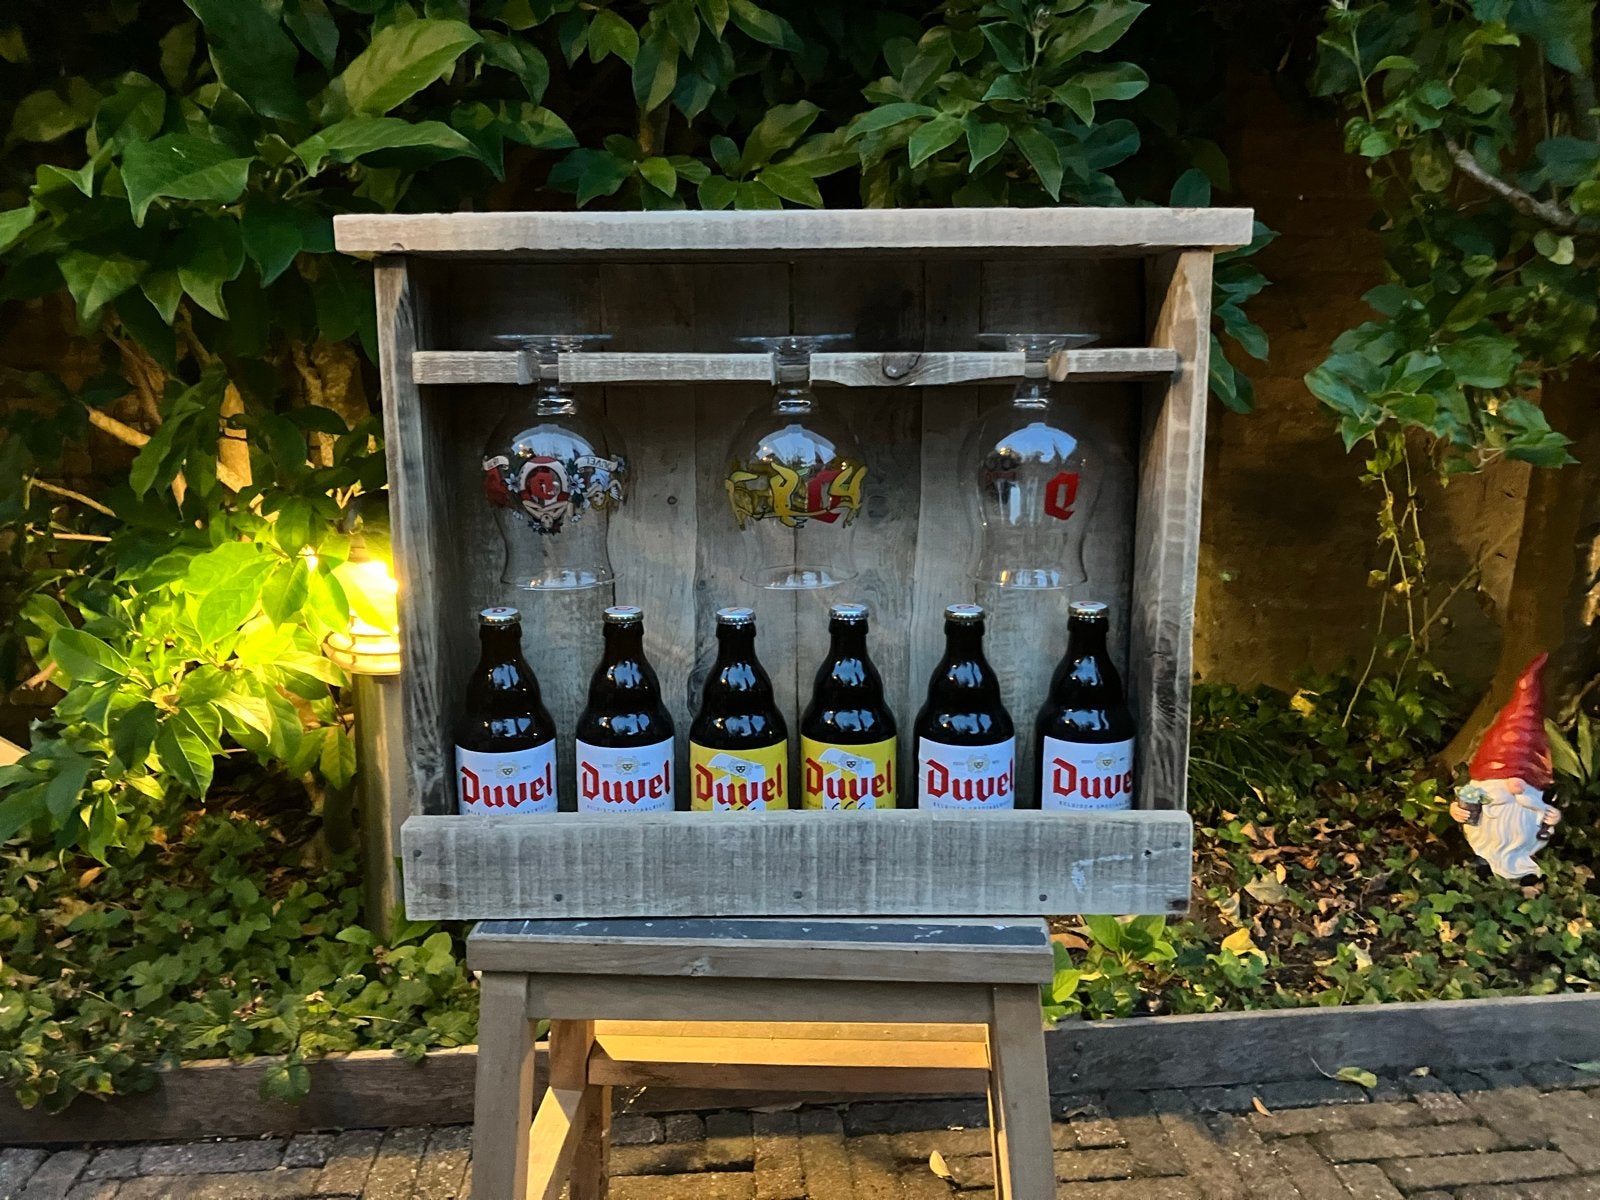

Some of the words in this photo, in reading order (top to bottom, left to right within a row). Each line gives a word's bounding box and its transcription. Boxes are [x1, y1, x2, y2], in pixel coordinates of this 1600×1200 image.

[460, 761, 553, 808] Duvel
[581, 760, 671, 805] Duvel
[695, 762, 783, 807] Duvel
[805, 759, 892, 802] Duvel
[926, 757, 1014, 802] Duvel
